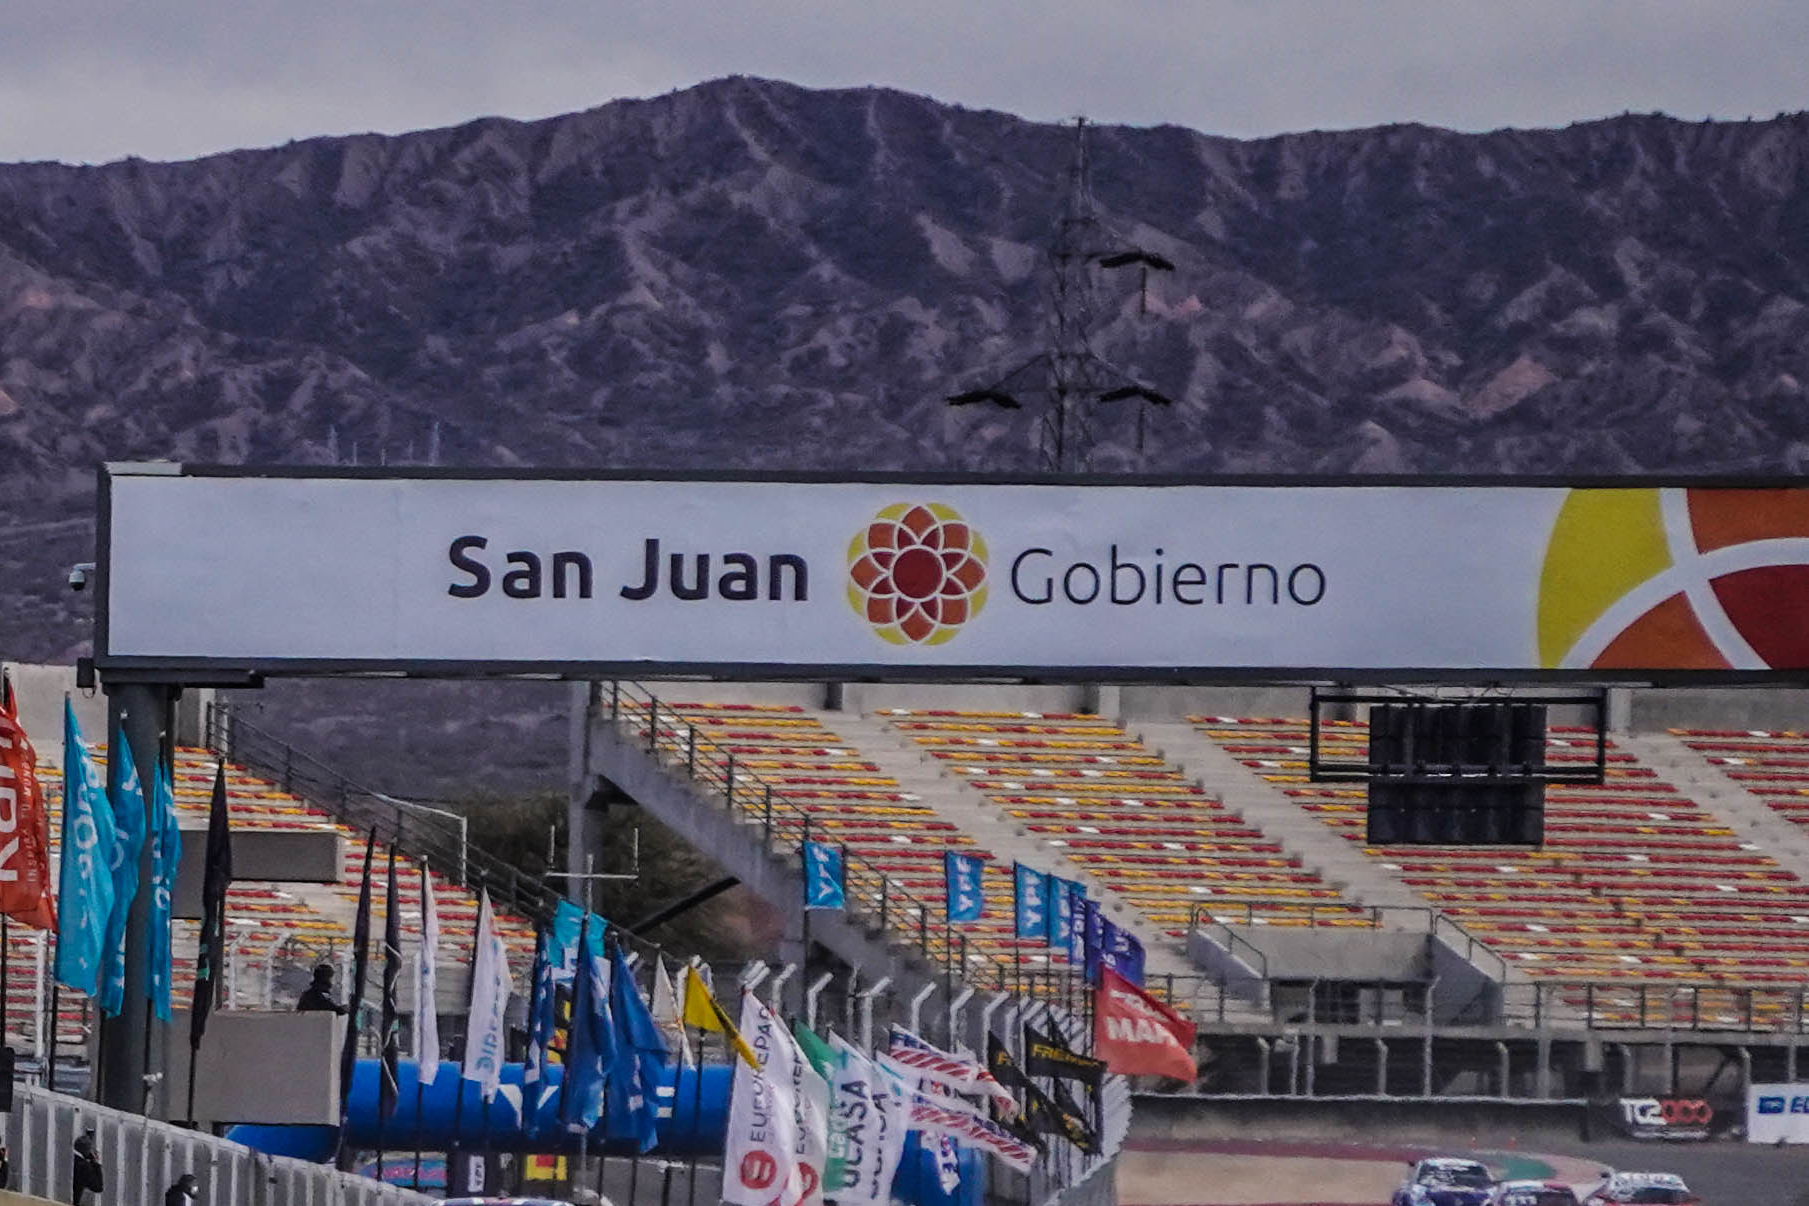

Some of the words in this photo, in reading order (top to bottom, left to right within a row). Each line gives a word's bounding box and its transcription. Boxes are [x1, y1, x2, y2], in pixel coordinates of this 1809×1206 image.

[448, 536, 592, 600] San
[621, 538, 809, 601] Juan
[1011, 545, 1326, 606] Gobierno
[956, 857, 973, 911] YPF
[1025, 872, 1042, 928] YPF
